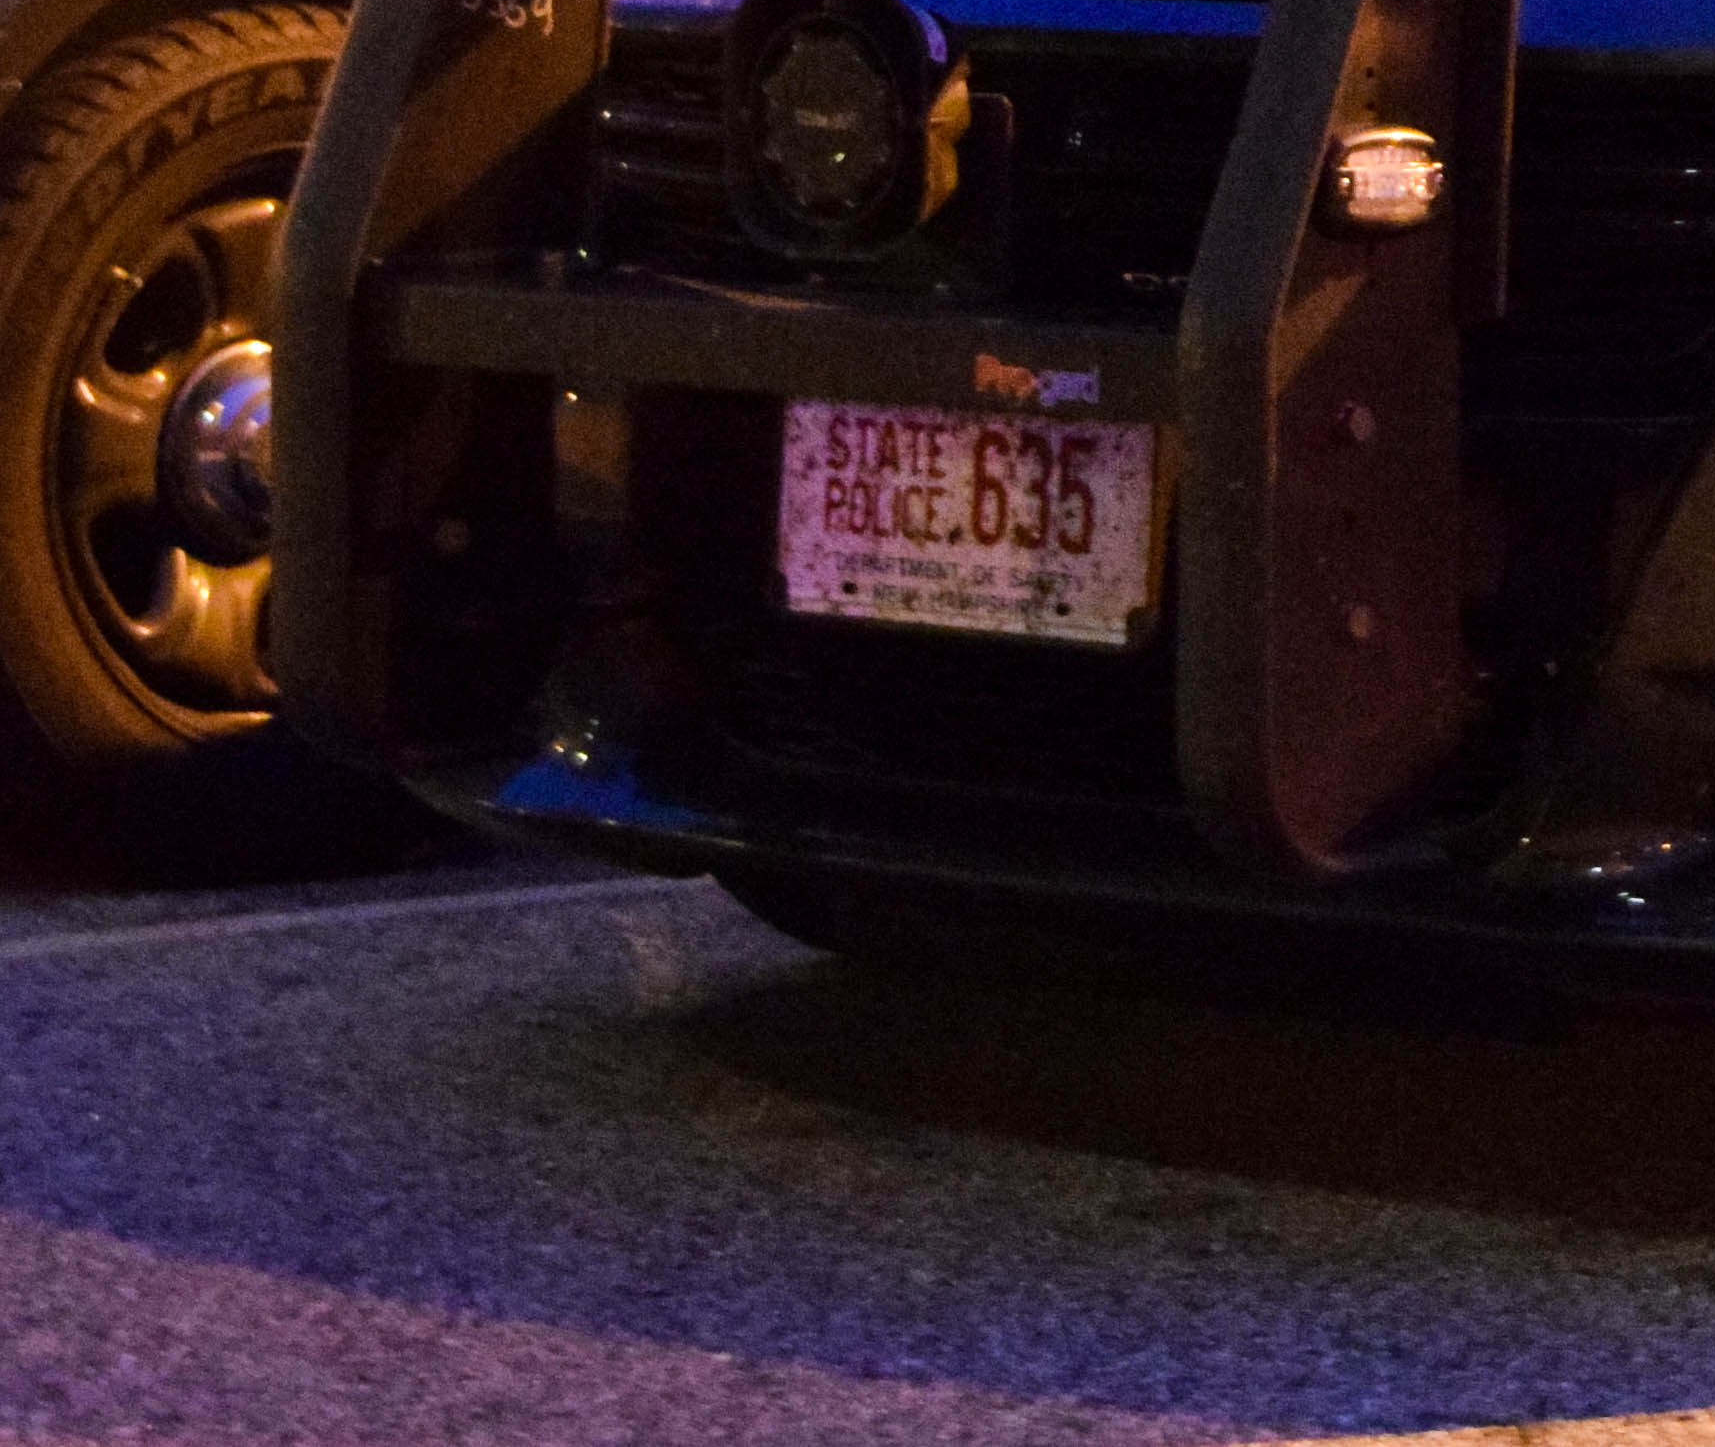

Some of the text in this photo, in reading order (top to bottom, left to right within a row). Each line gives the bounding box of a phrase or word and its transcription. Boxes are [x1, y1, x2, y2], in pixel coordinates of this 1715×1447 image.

[825, 413, 947, 479] STATE
[823, 478, 946, 543] POLICE
[971, 427, 1098, 555] 635
